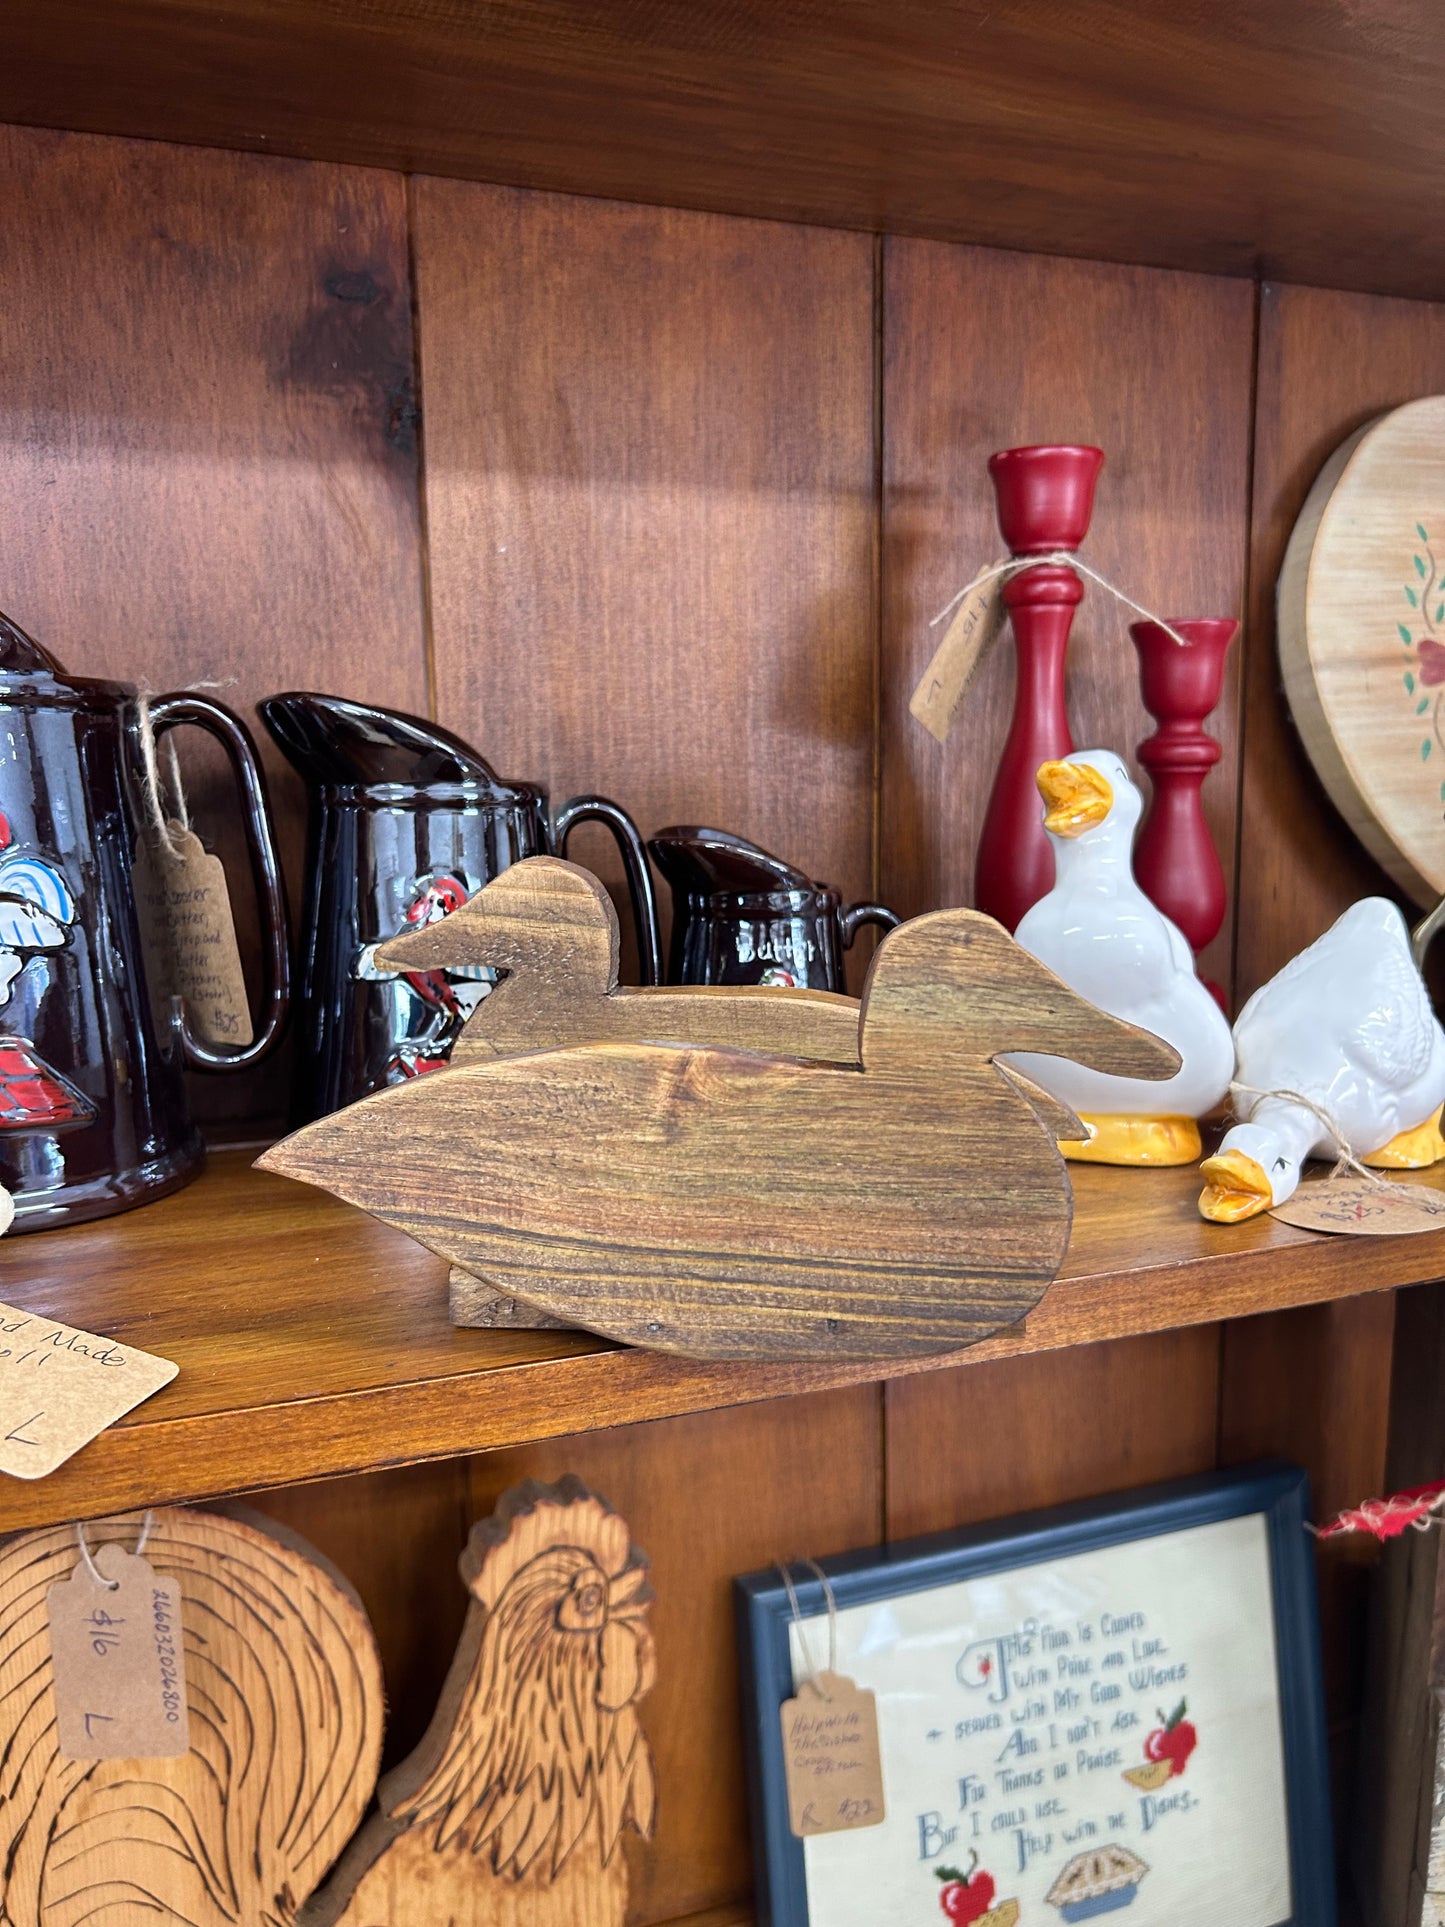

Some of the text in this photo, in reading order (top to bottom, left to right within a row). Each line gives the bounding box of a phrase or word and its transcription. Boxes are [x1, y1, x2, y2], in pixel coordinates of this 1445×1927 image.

[736, 932, 816, 963] Buttr
[210, 1006, 240, 1035] $25
[39, 1330, 127, 1368] Made
[83, 1608, 126, 1657] $16
[84, 1712, 114, 1740] L
